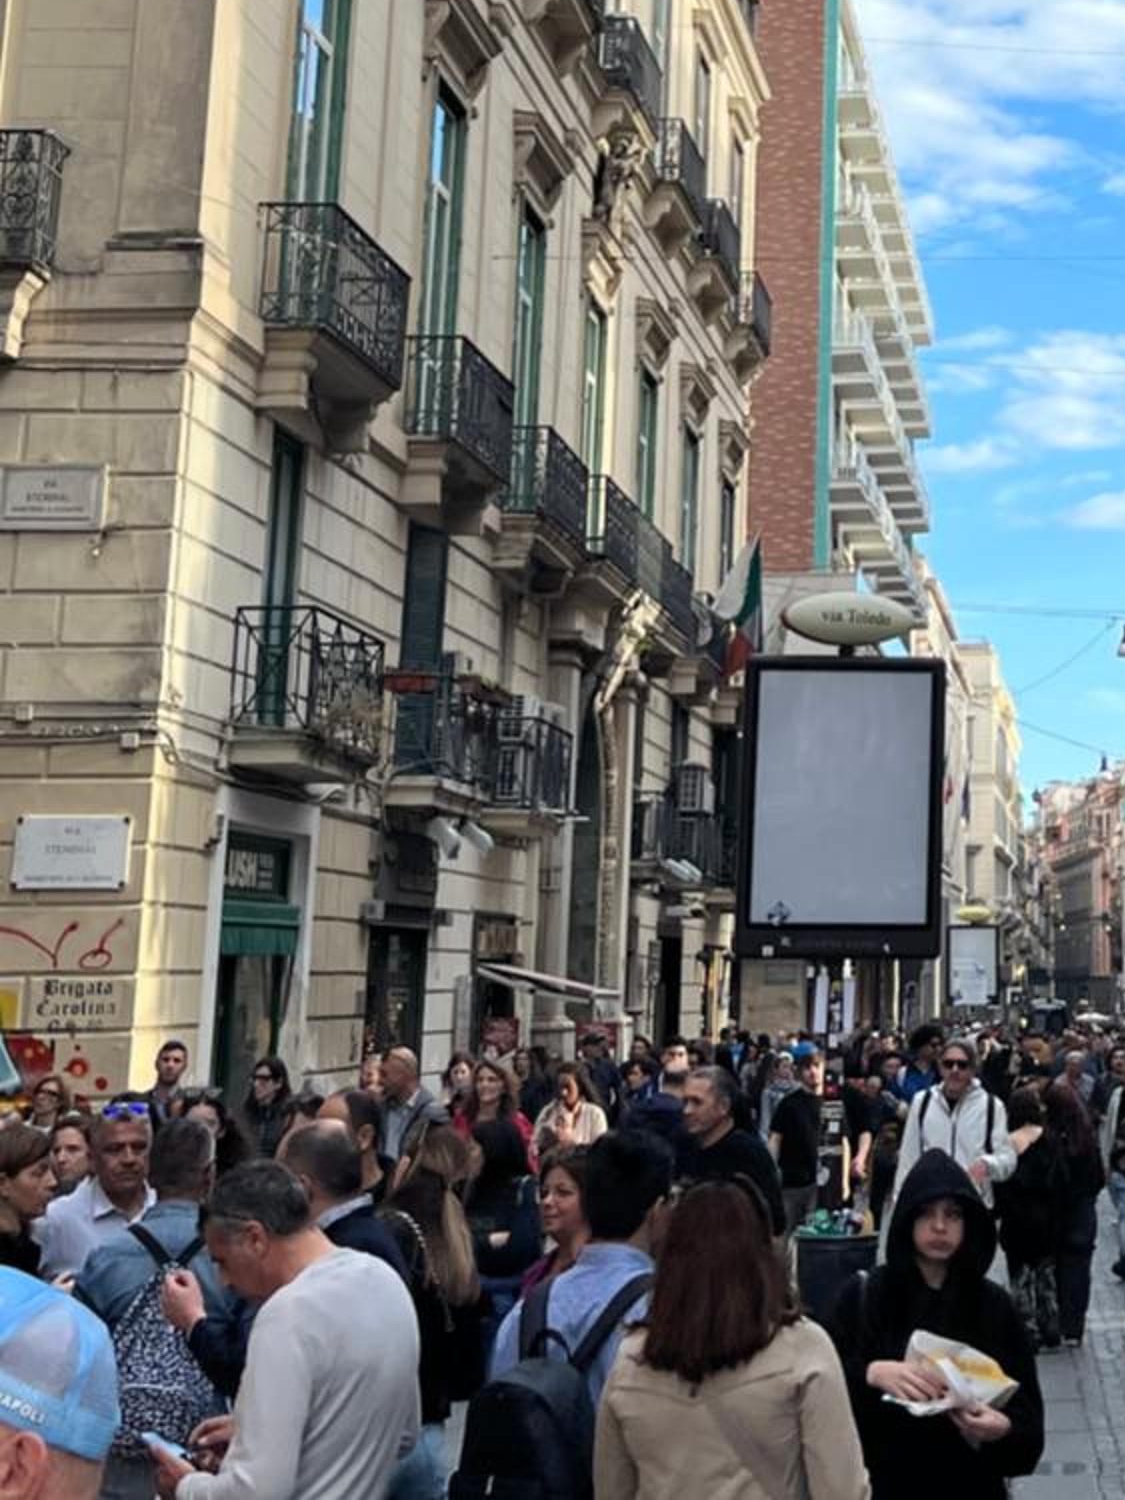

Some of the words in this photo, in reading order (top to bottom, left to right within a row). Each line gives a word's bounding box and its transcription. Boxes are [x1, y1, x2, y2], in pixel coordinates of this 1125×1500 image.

[820, 611, 844, 622] via
[847, 607, 892, 626] Toledo
[45, 979, 113, 999] Brigata
[36, 997, 117, 1016] Carolina
